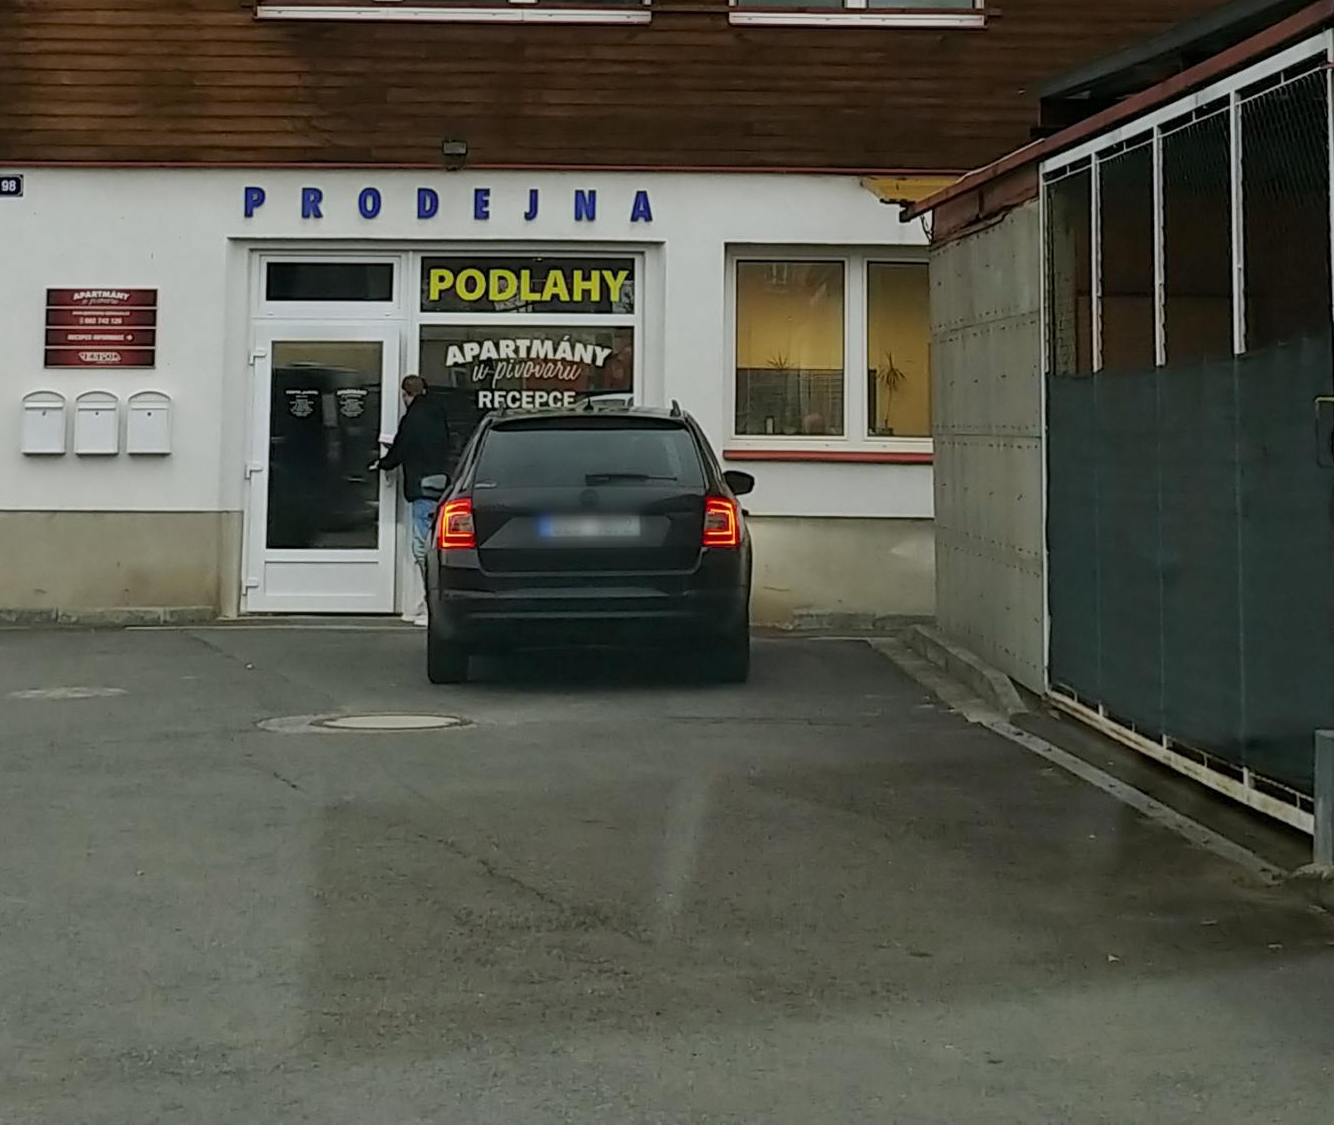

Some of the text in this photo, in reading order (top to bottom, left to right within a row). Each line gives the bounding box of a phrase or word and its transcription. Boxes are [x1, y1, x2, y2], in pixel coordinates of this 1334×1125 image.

[1, 179, 17, 192] 98
[243, 186, 653, 222] PRODEJNA
[429, 268, 629, 302] PODLAHY
[444, 335, 612, 367] APARTMÁNY
[492, 359, 583, 388] pivovaru
[478, 390, 576, 409] RECEPCE
